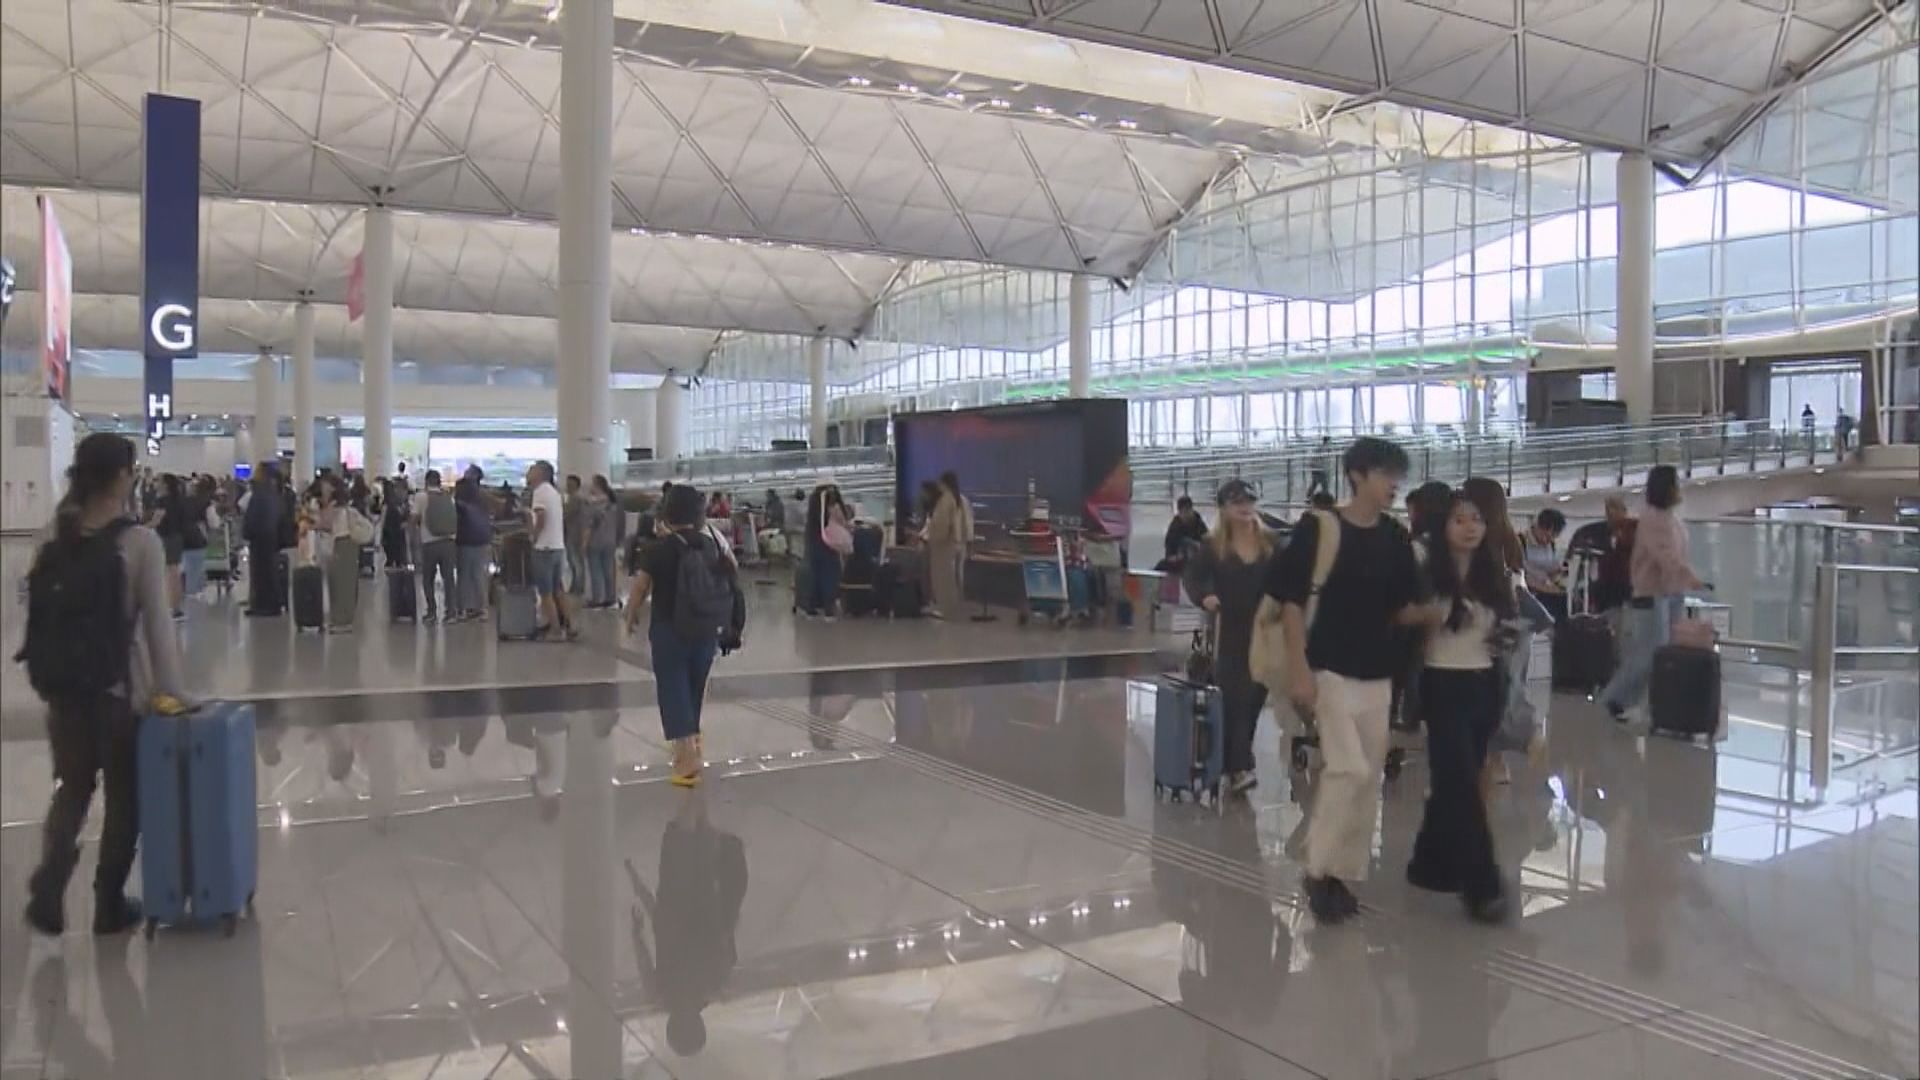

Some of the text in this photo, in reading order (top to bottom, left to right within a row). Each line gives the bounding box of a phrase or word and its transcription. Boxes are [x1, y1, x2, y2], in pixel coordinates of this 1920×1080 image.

[151, 304, 193, 349] G
[149, 394, 170, 418] H
[150, 421, 163, 439] J
